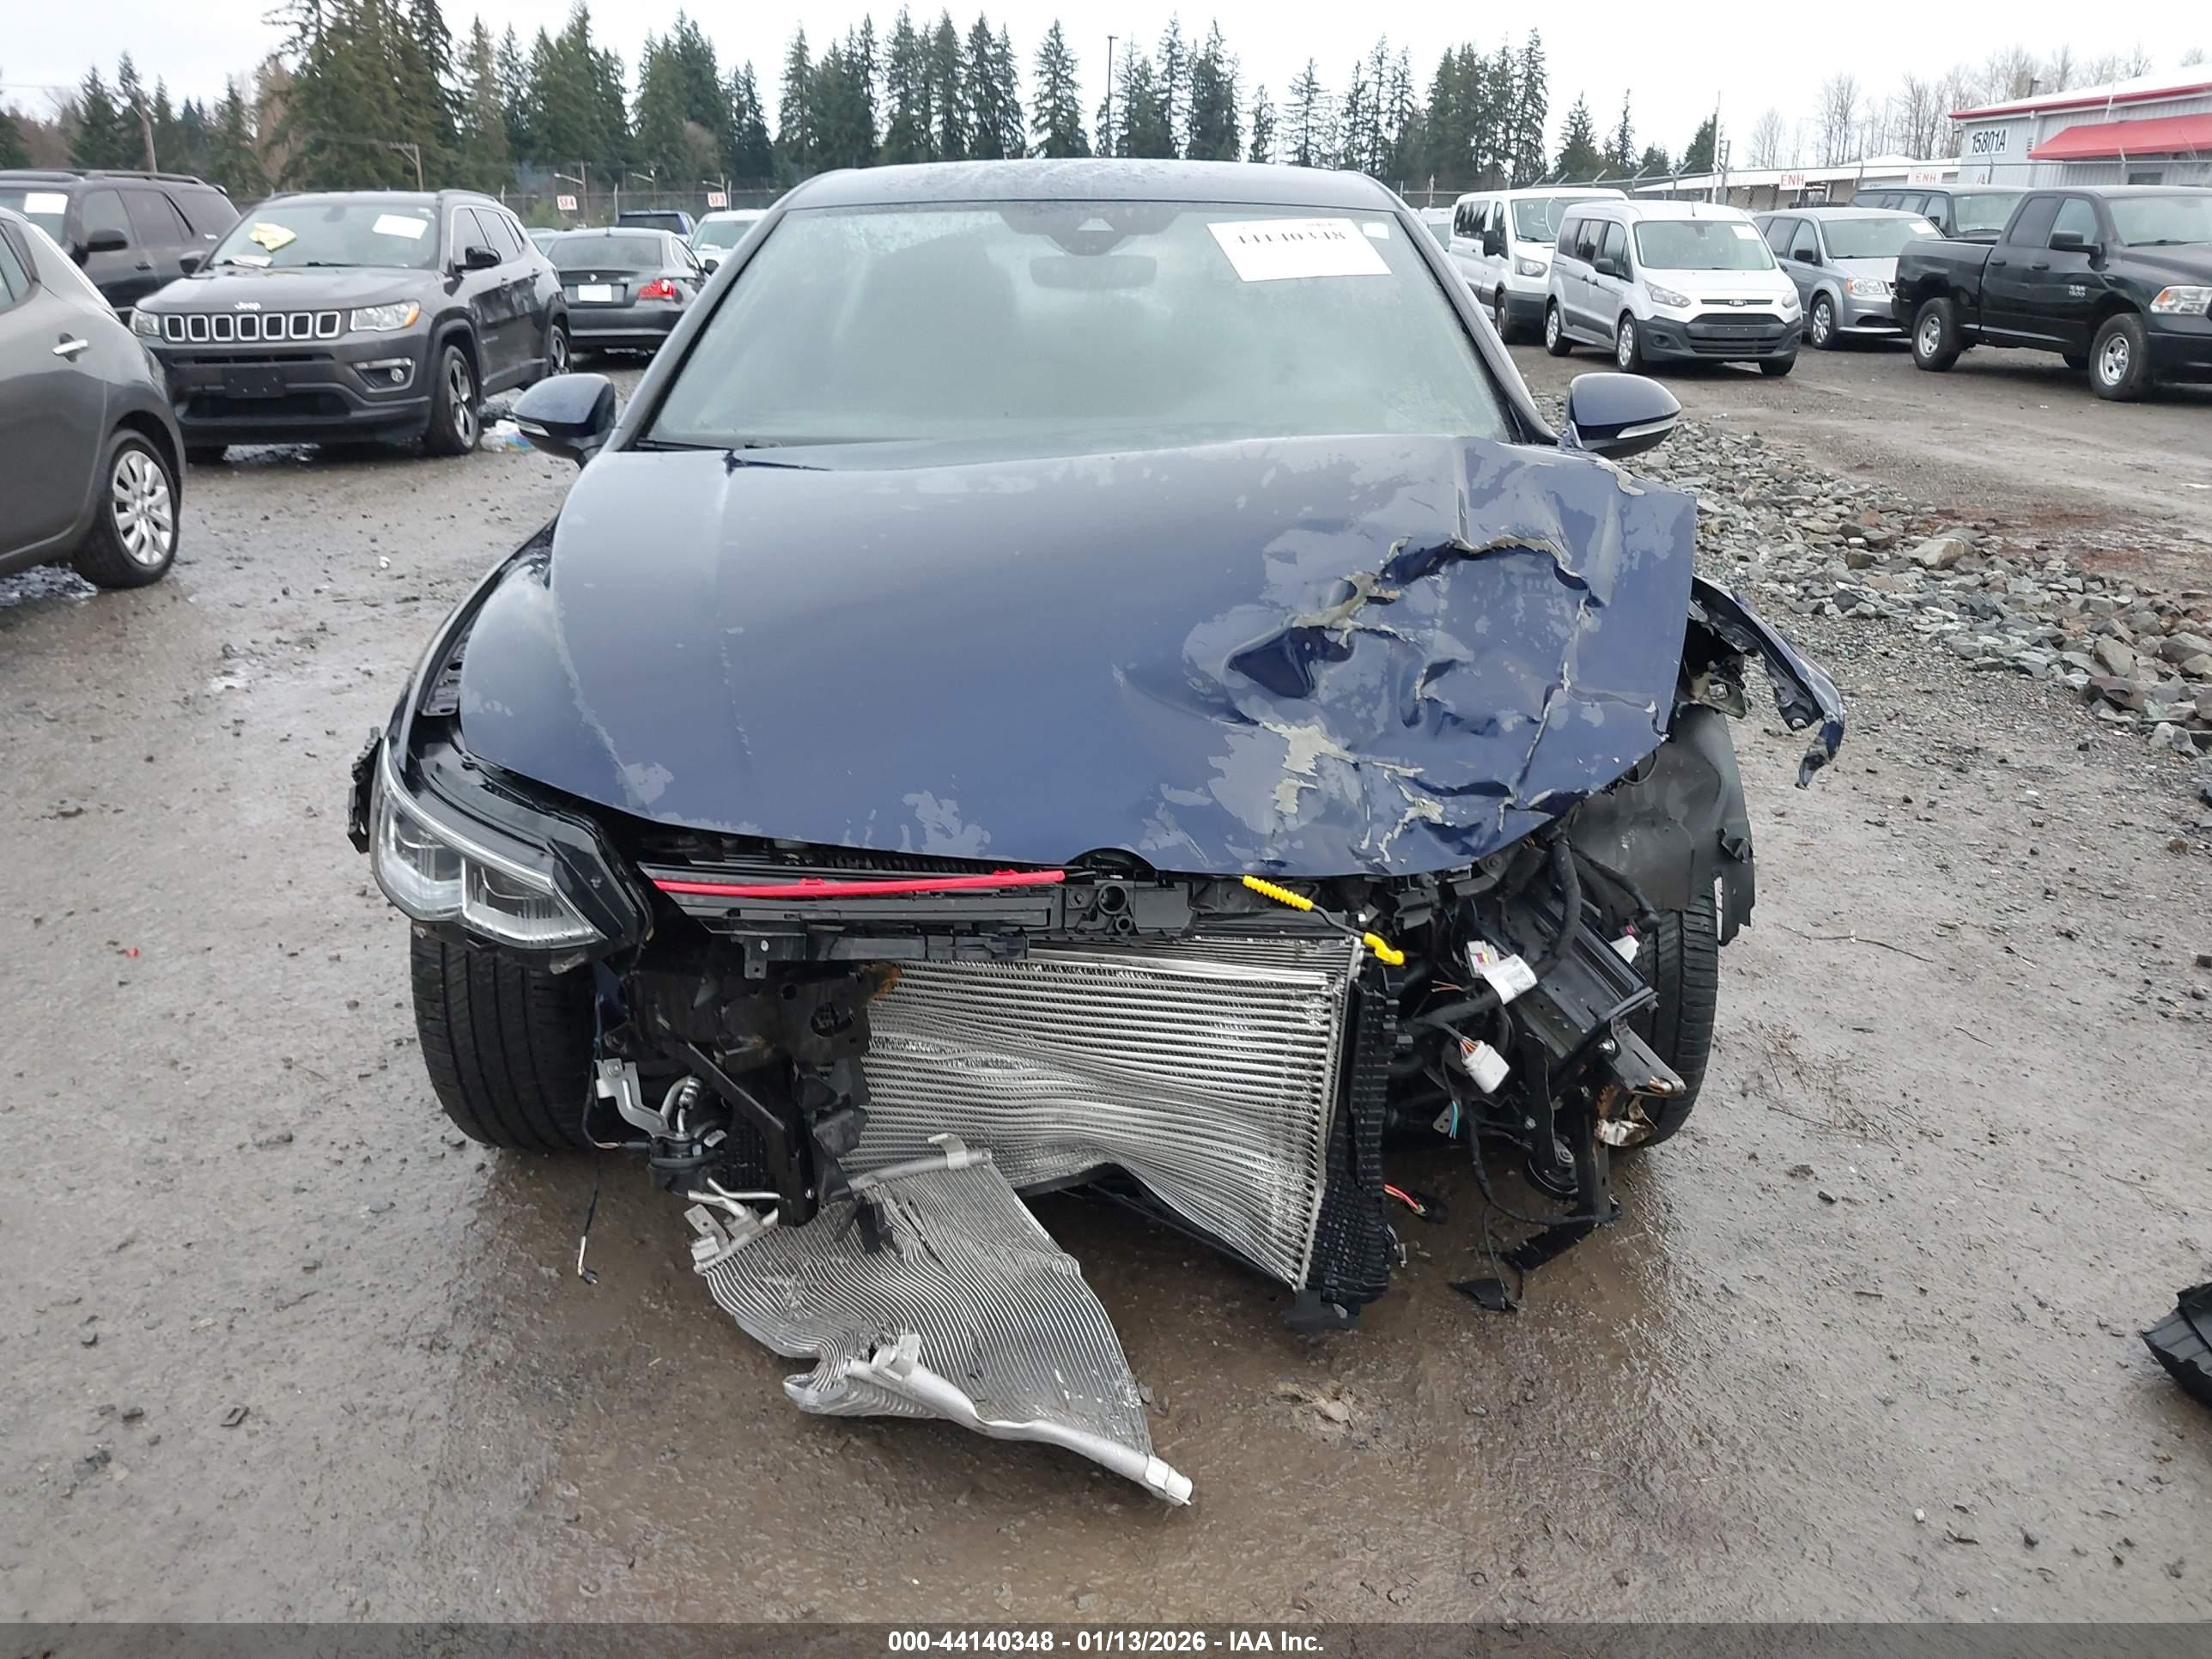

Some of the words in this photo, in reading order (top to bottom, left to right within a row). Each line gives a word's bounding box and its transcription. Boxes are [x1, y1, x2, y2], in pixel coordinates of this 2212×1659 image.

[1972, 129, 2007, 153] 15801A
[1780, 174, 1805, 186] ENH
[1915, 173, 1936, 184] ENH
